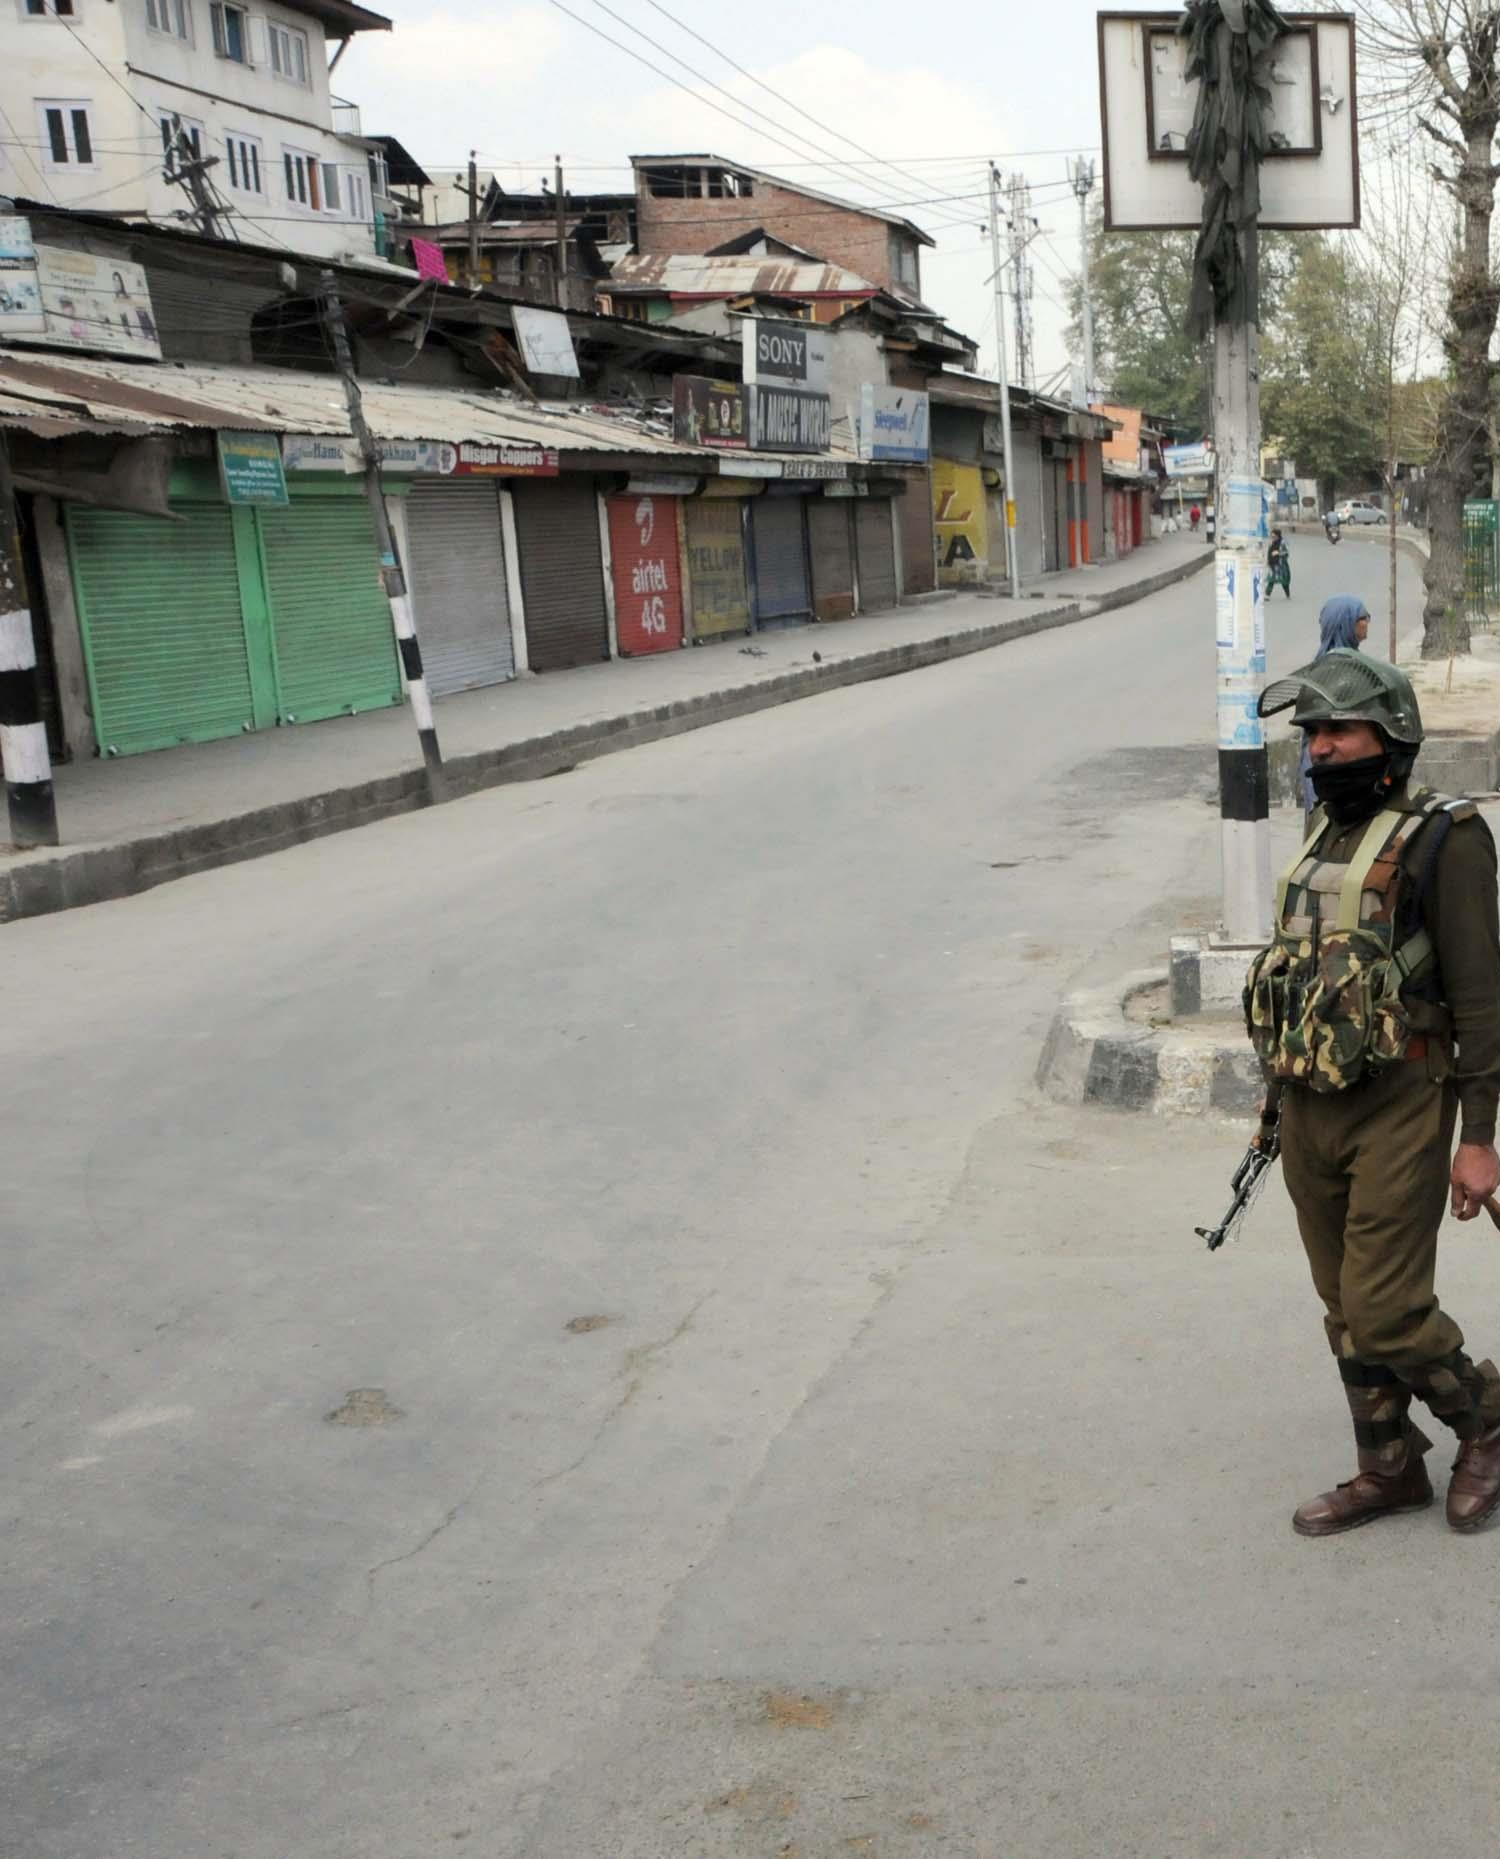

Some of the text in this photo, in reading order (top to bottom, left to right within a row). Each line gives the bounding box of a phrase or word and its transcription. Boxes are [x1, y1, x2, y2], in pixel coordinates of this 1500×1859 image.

[758, 333, 803, 366] SONY
[500, 446, 544, 467] Coppers
[632, 558, 668, 594] airtel
[641, 595, 667, 636] 4G
